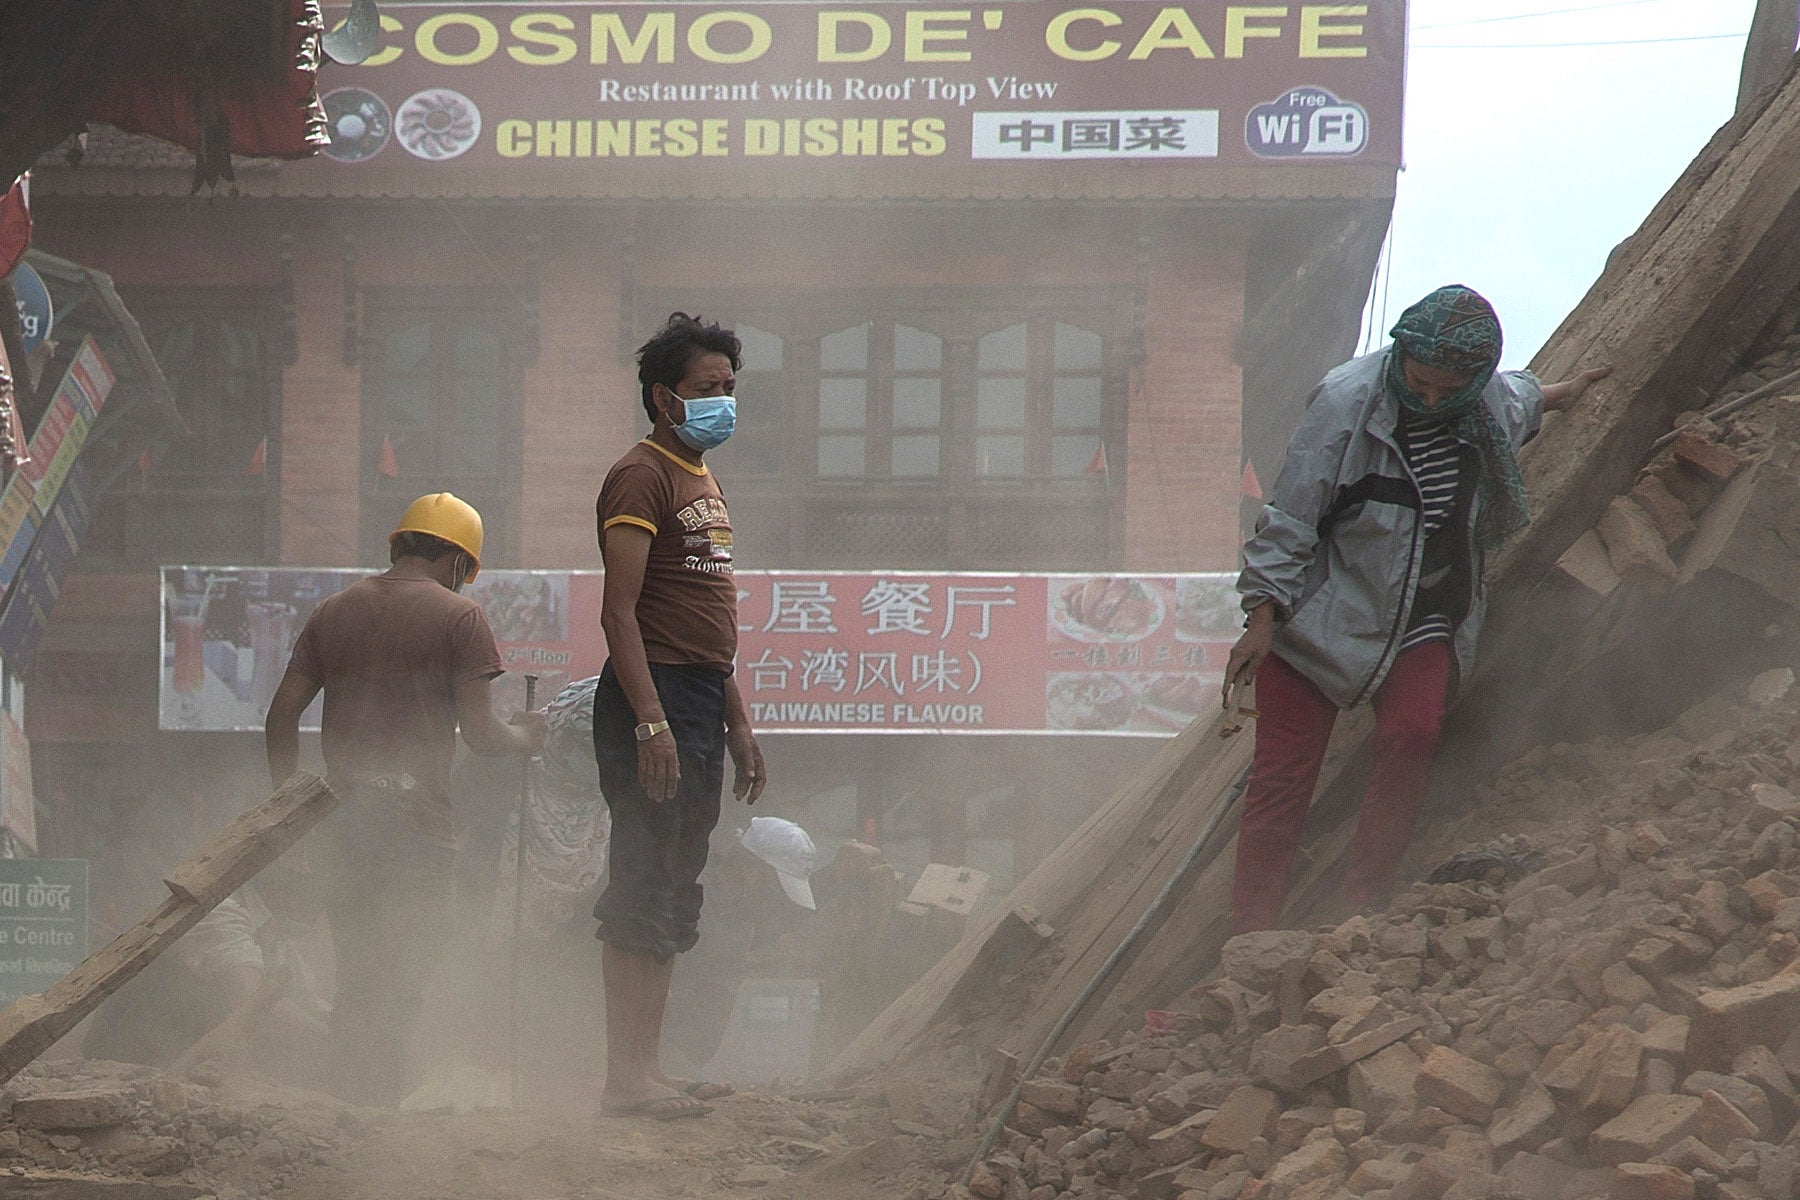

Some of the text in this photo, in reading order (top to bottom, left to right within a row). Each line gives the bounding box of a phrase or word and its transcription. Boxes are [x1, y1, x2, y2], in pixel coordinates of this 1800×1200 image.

[817, 10, 1003, 64] DE'
[1045, 6, 1369, 61] CAFE
[600, 77, 1058, 106] Restaurant with Roof Top View
[1288, 93, 1326, 107] Free
[496, 117, 946, 158] CHINESE DISHES
[999, 117, 1187, 153] 中国菜
[737, 579, 1017, 641] 屋餐厅
[530, 647, 572, 665] Floor
[750, 703, 984, 725] TAIWANESE FLAVOR
[14, 926, 75, 946] Centre
